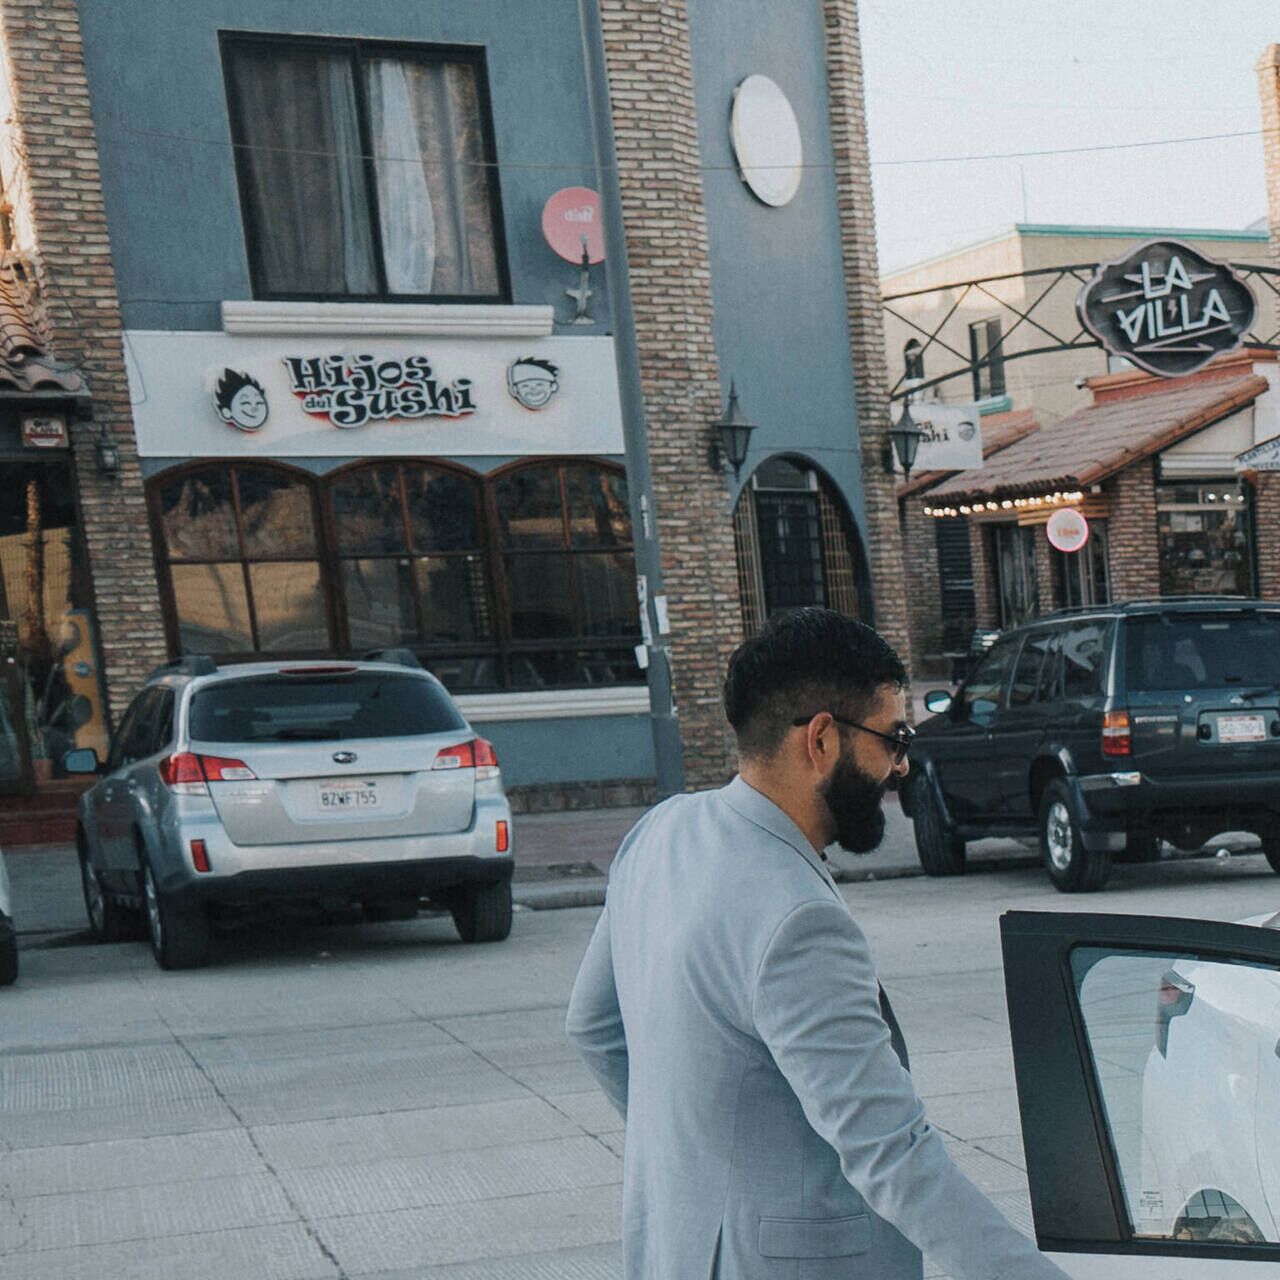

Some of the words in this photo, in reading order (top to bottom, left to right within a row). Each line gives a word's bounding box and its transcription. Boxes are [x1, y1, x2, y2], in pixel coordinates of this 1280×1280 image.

[1142, 256, 1193, 299] LA
[1116, 289, 1231, 343] VILLA
[284, 354, 433, 391] Hijos
[333, 378, 476, 424] Sushi
